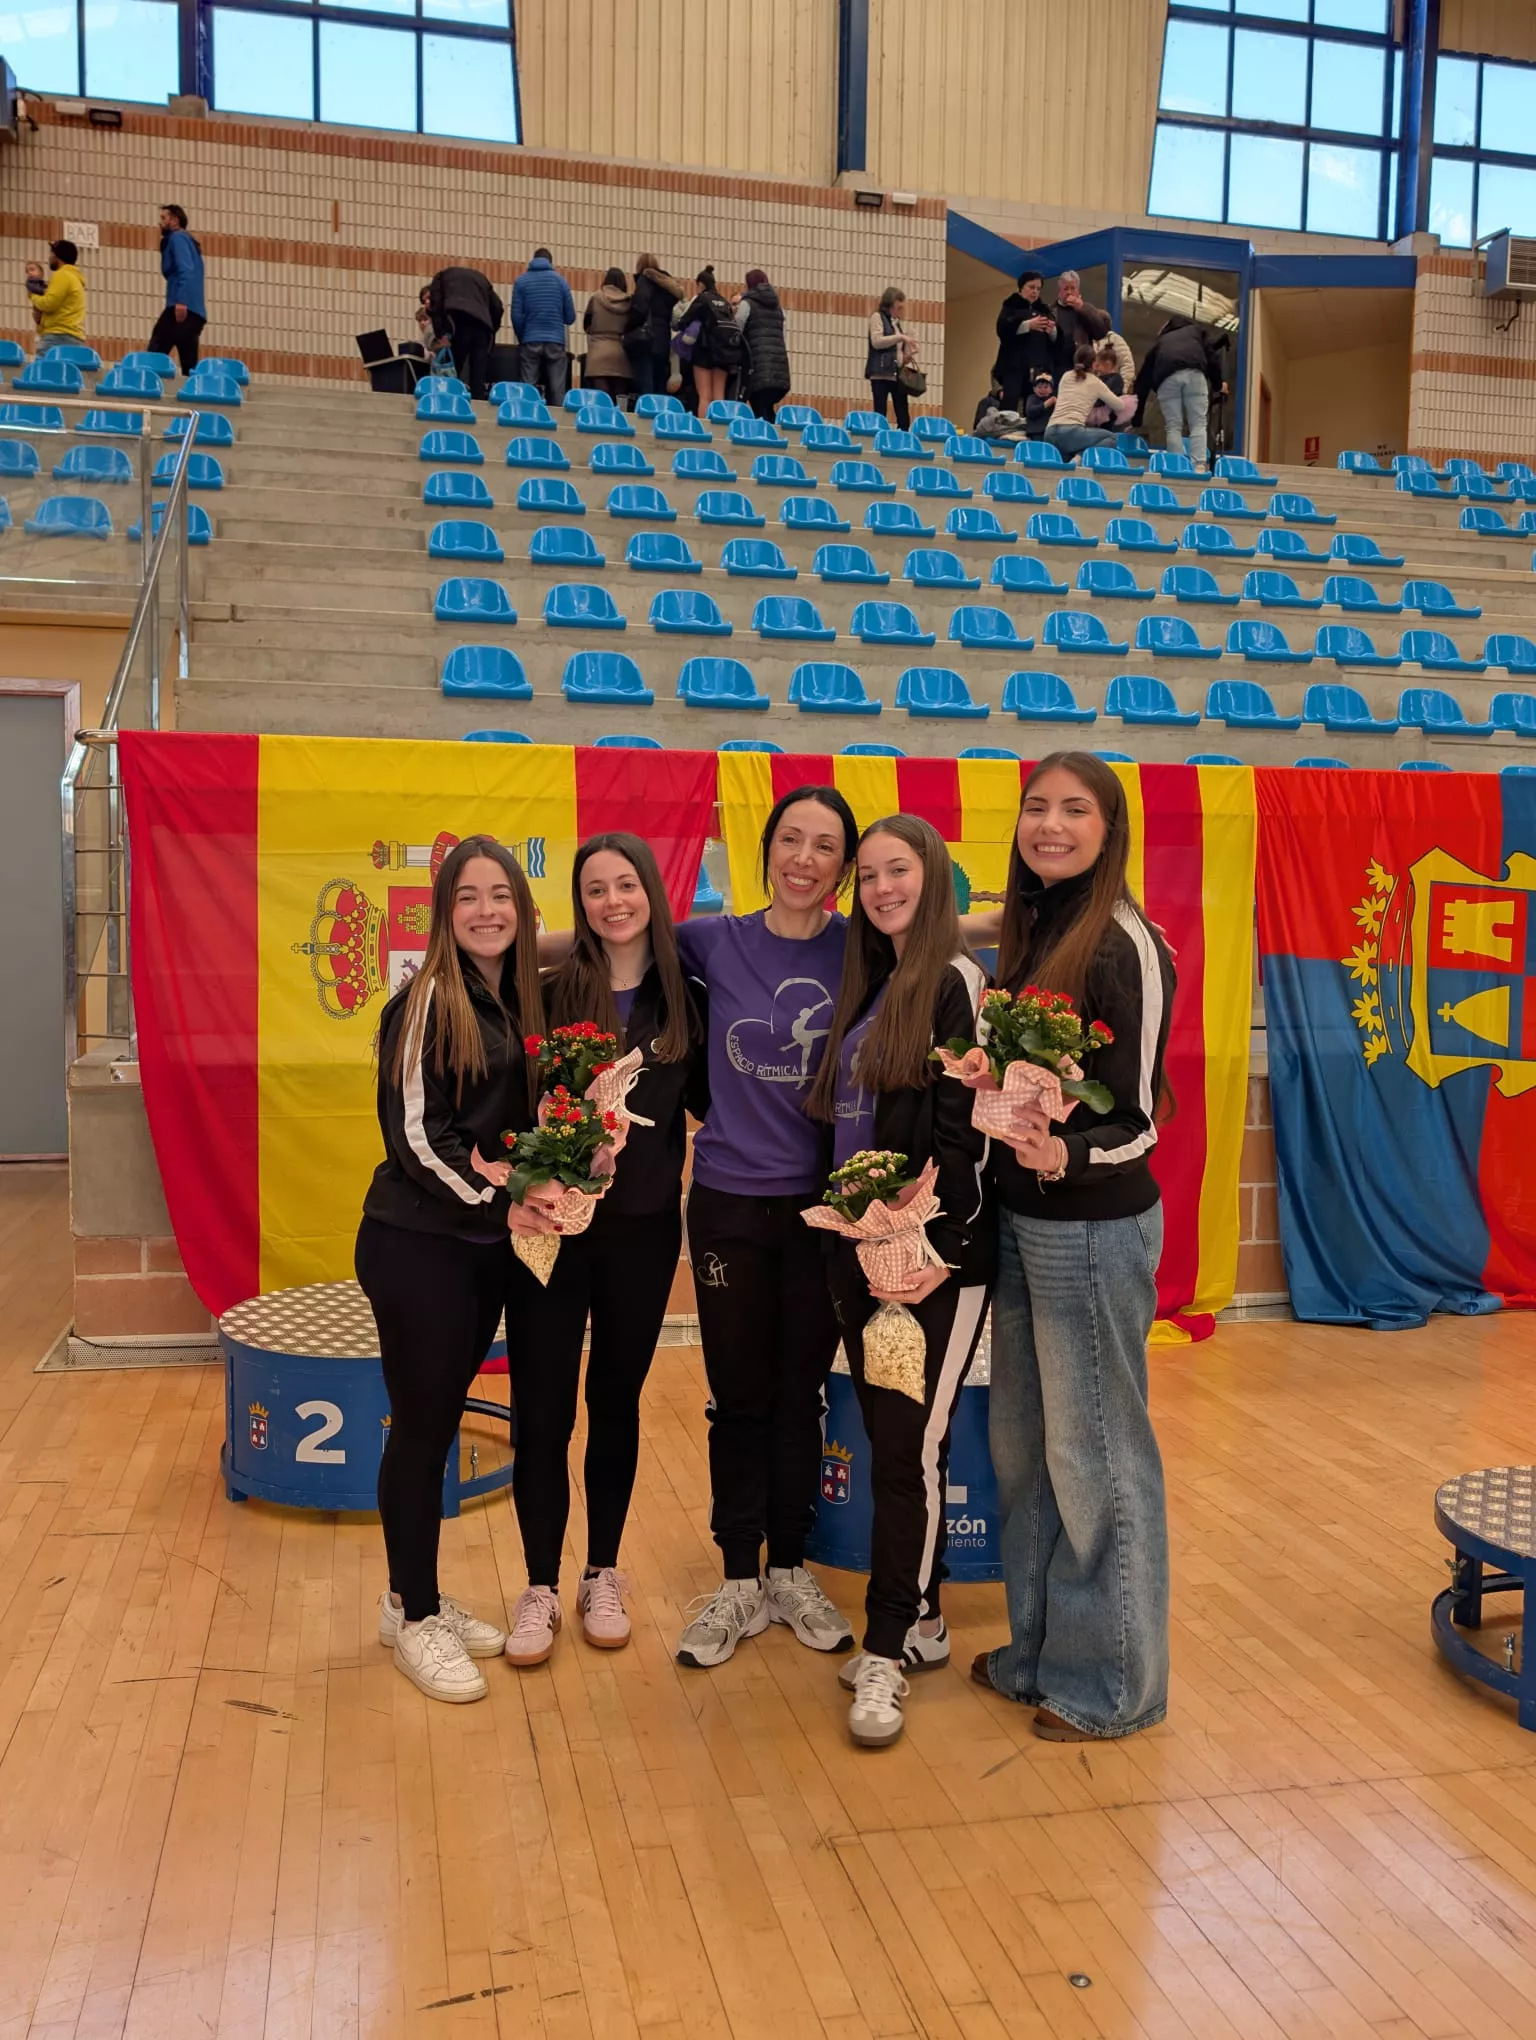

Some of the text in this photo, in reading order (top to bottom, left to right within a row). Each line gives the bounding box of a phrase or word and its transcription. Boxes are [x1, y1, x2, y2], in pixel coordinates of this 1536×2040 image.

[66, 225, 96, 241] BAR
[730, 1034, 799, 1077] ESPACIO RÍTMICA
[295, 1400, 346, 1464] 2
[945, 1514, 986, 1535] zón
